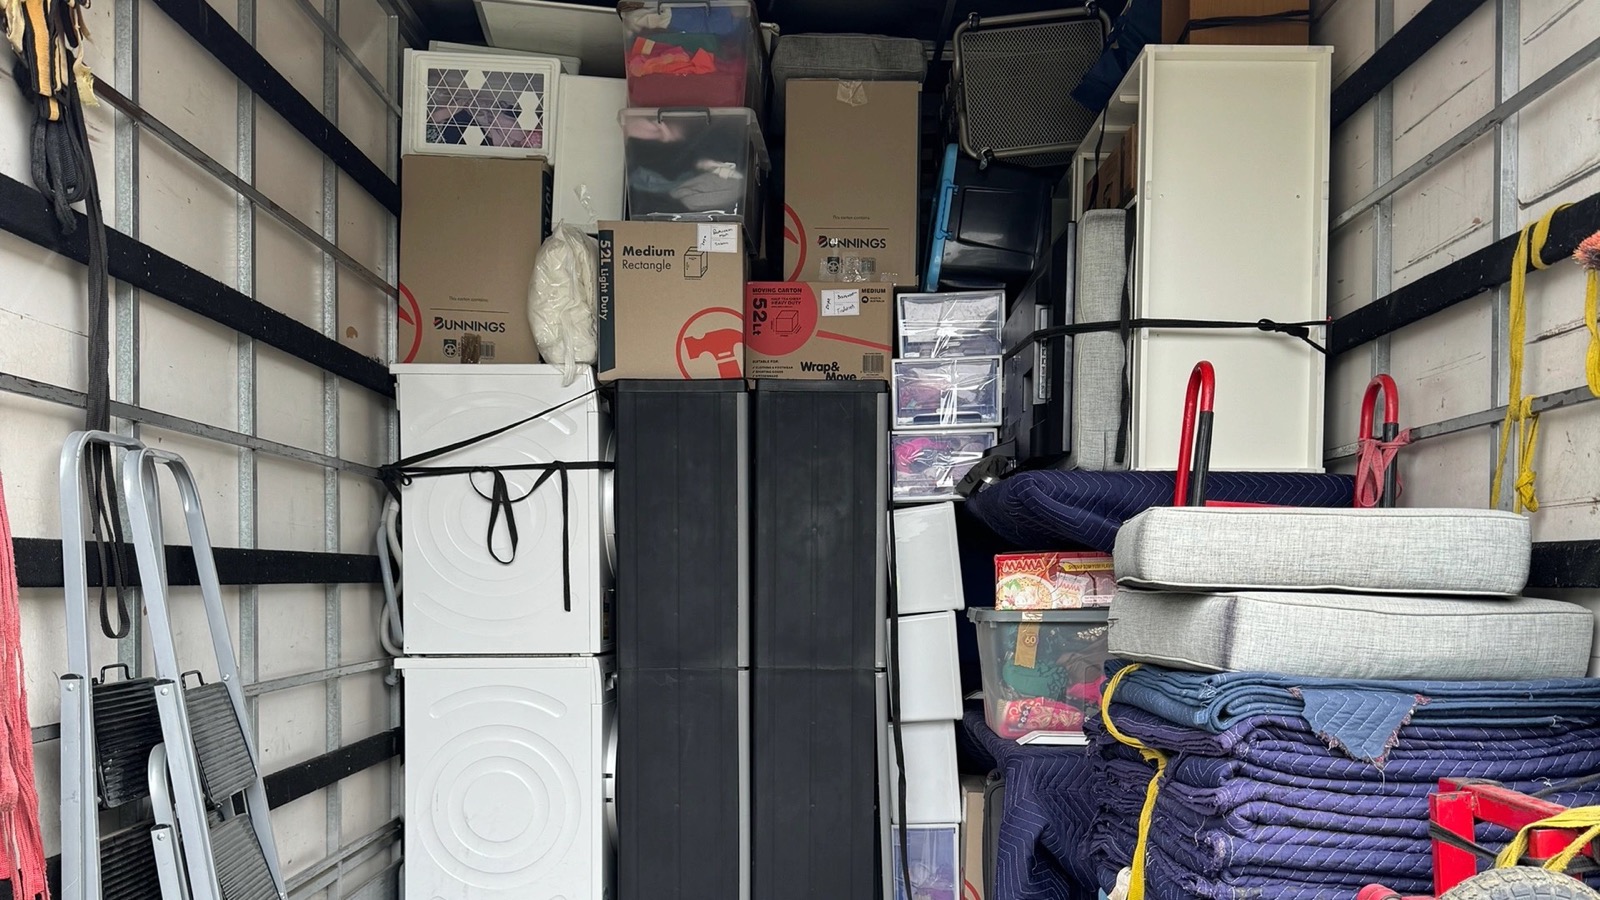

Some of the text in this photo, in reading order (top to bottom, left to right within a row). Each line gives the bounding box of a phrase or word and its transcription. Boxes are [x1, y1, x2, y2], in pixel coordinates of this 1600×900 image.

[817, 235, 887, 248] BUNNINGS
[622, 245, 675, 256] Medium
[622, 259, 672, 272] Rectangle
[599, 240, 611, 320] 52L Light Duty
[753, 298, 767, 336] 52Lt
[433, 316, 506, 333] BUNNINGS
[800, 361, 840, 374] Wrap&
[826, 372, 857, 380] Move
[1003, 559, 1045, 572] MAMA
[1025, 636, 1036, 644] 60
